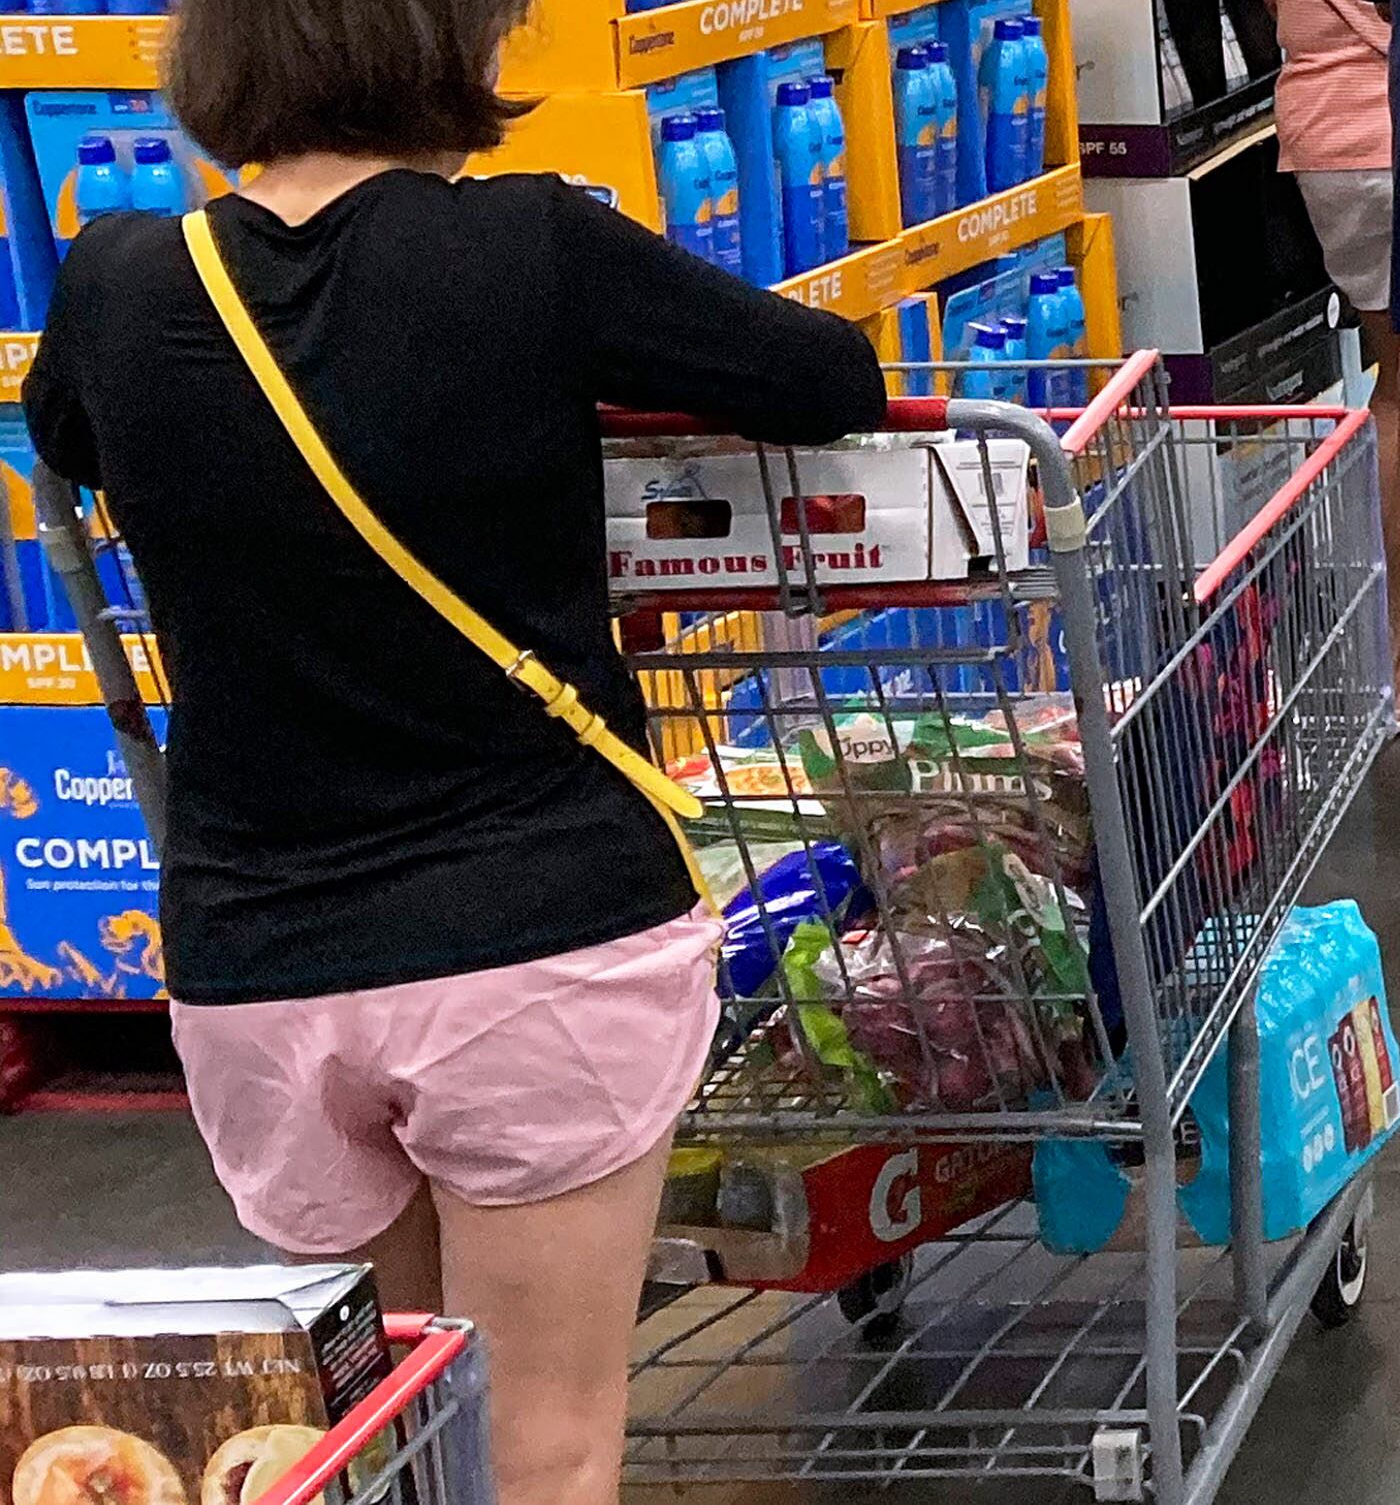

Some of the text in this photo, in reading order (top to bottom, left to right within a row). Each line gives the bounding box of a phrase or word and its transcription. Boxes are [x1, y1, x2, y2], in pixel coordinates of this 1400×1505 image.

[957, 190, 1037, 243] COMPLETE
[609, 543, 884, 578] Famous Fruit
[55, 768, 134, 806] Copper
[16, 837, 160, 870] COMPL
